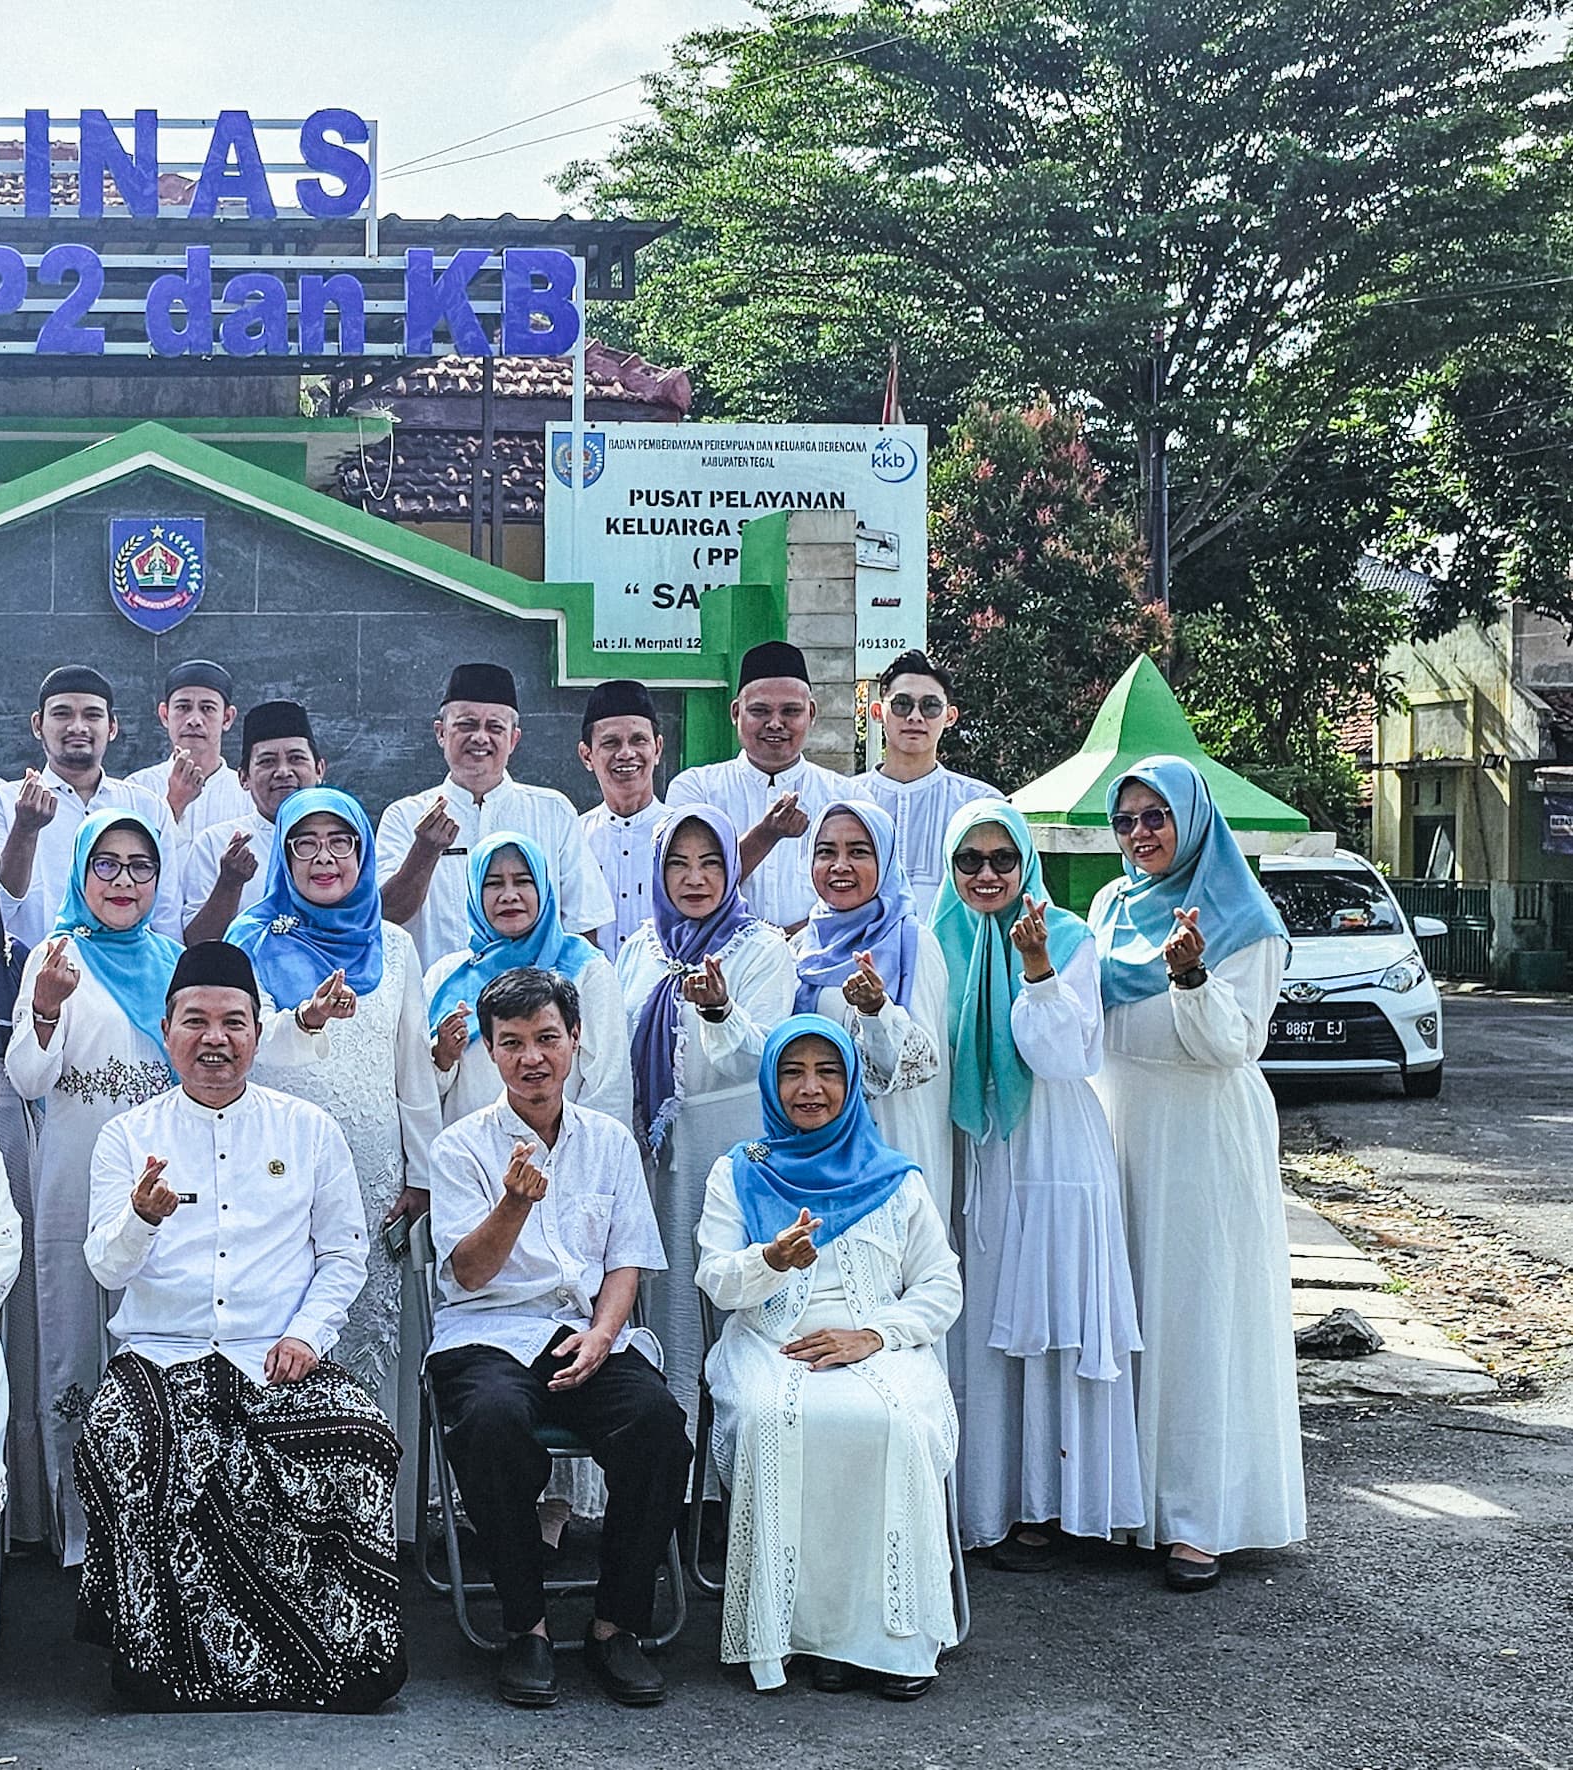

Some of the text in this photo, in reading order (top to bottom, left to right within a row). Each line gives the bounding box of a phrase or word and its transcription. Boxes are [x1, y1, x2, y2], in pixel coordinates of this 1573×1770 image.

[146, 245, 366, 358] dan
[405, 246, 581, 358] KB
[609, 439, 867, 453] BADAN PEMBERDAYAAN PEREMPUAN DAN KELUARGA BERENCANA
[701, 456, 775, 469] KABUPATEN TEGAL
[871, 453, 905, 469] kkb
[629, 489, 846, 509] PUSAT PELAYANAN
[606, 517, 731, 536] KELUARGA
[708, 548, 739, 566] PP
[652, 583, 726, 610] SA
[635, 638, 682, 651] Merpati
[1269, 1021, 1278, 1036] G
[1327, 1021, 1343, 1036] EJ
